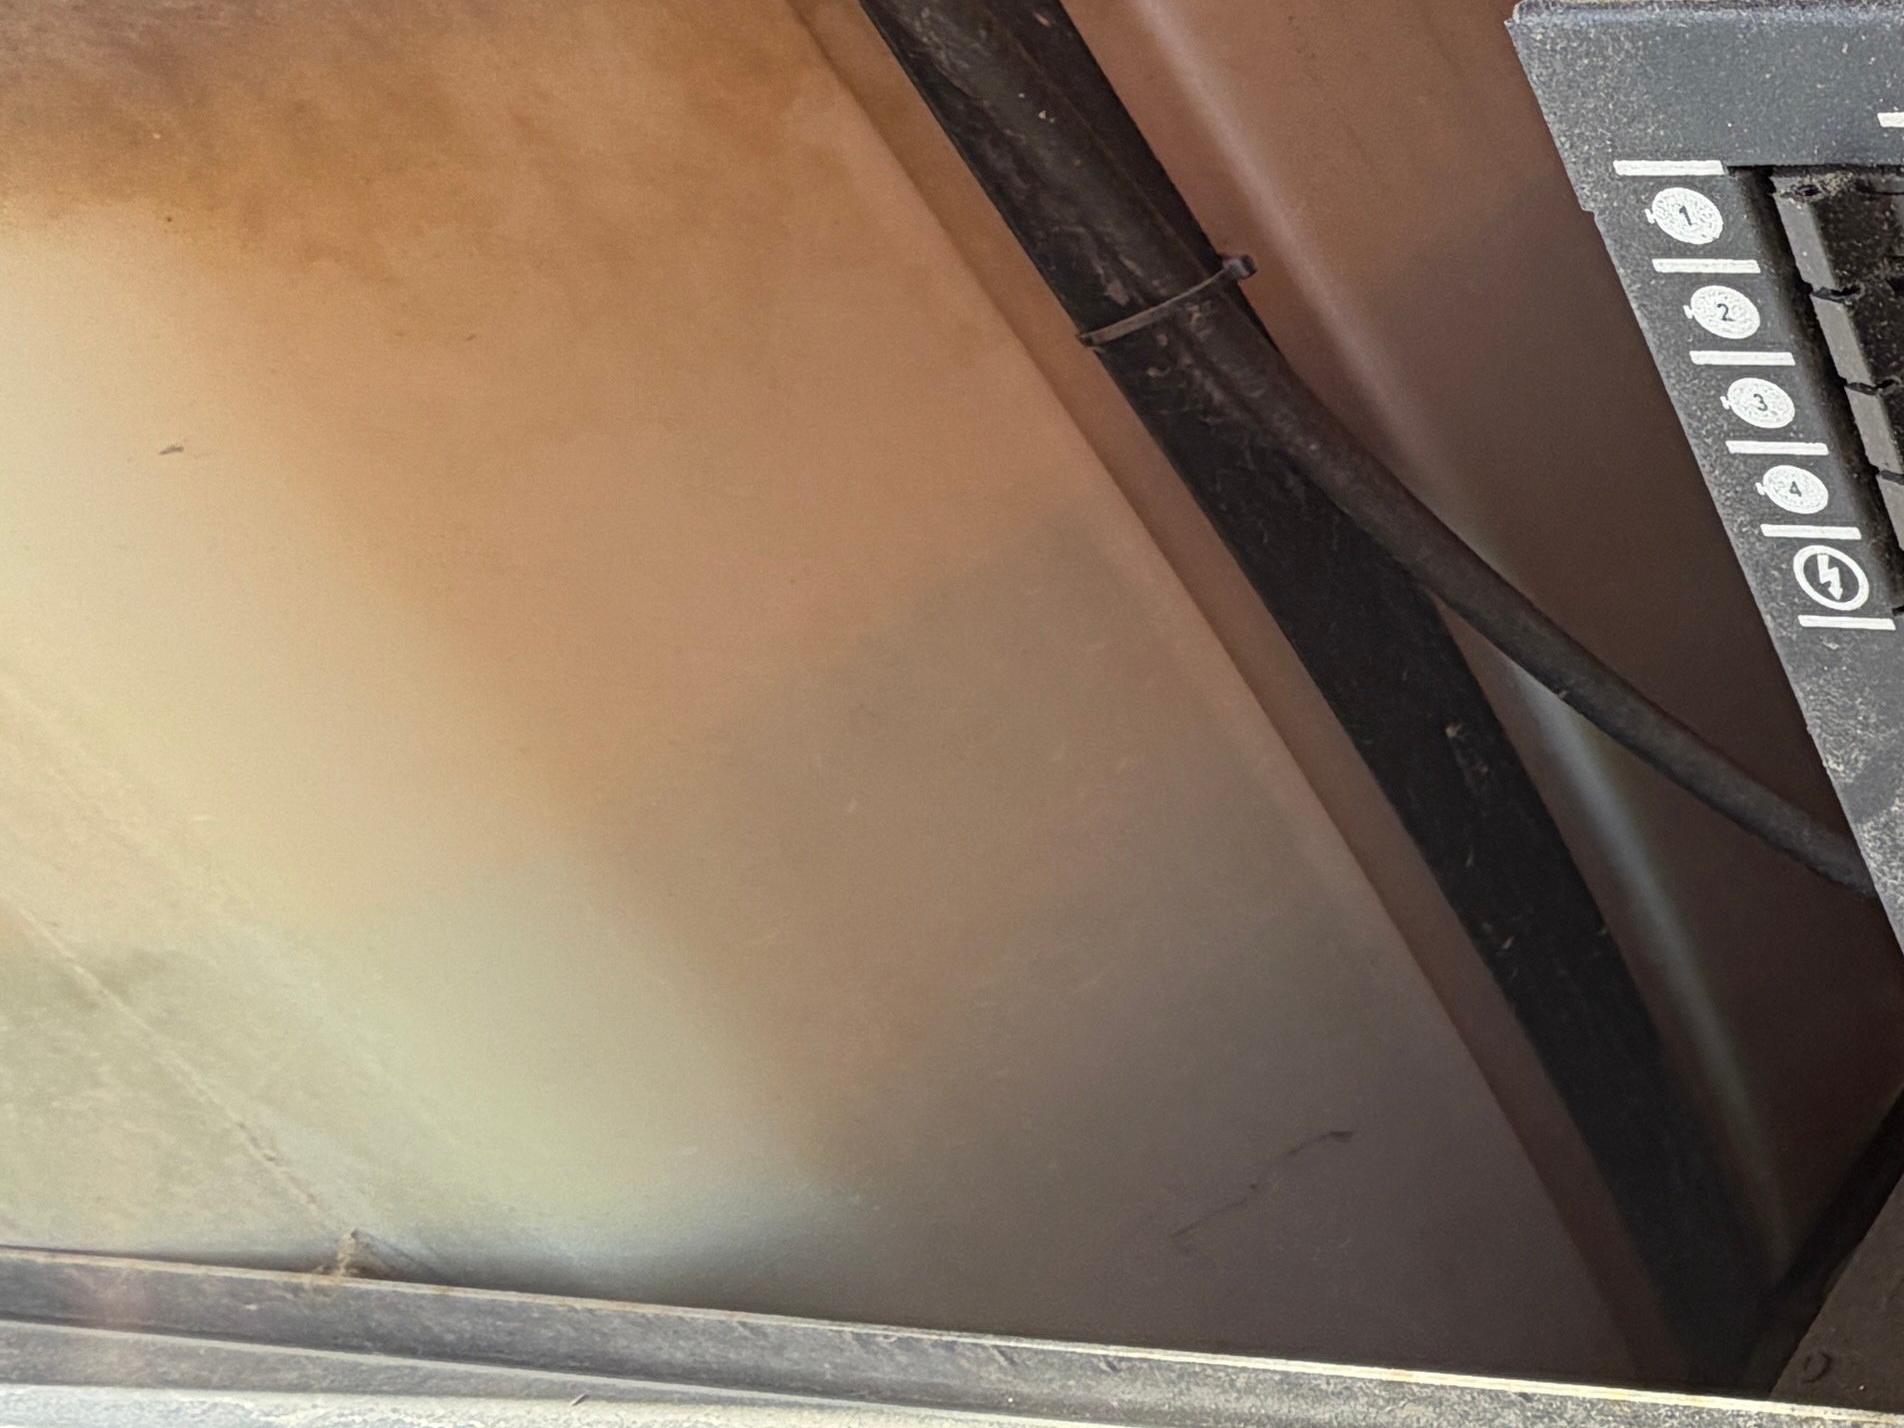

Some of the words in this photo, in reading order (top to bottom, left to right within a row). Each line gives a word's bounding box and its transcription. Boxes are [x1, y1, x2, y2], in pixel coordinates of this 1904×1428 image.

[1677, 205, 1695, 227] 1
[1716, 302, 1736, 323] 2
[1752, 392, 1769, 412] 3
